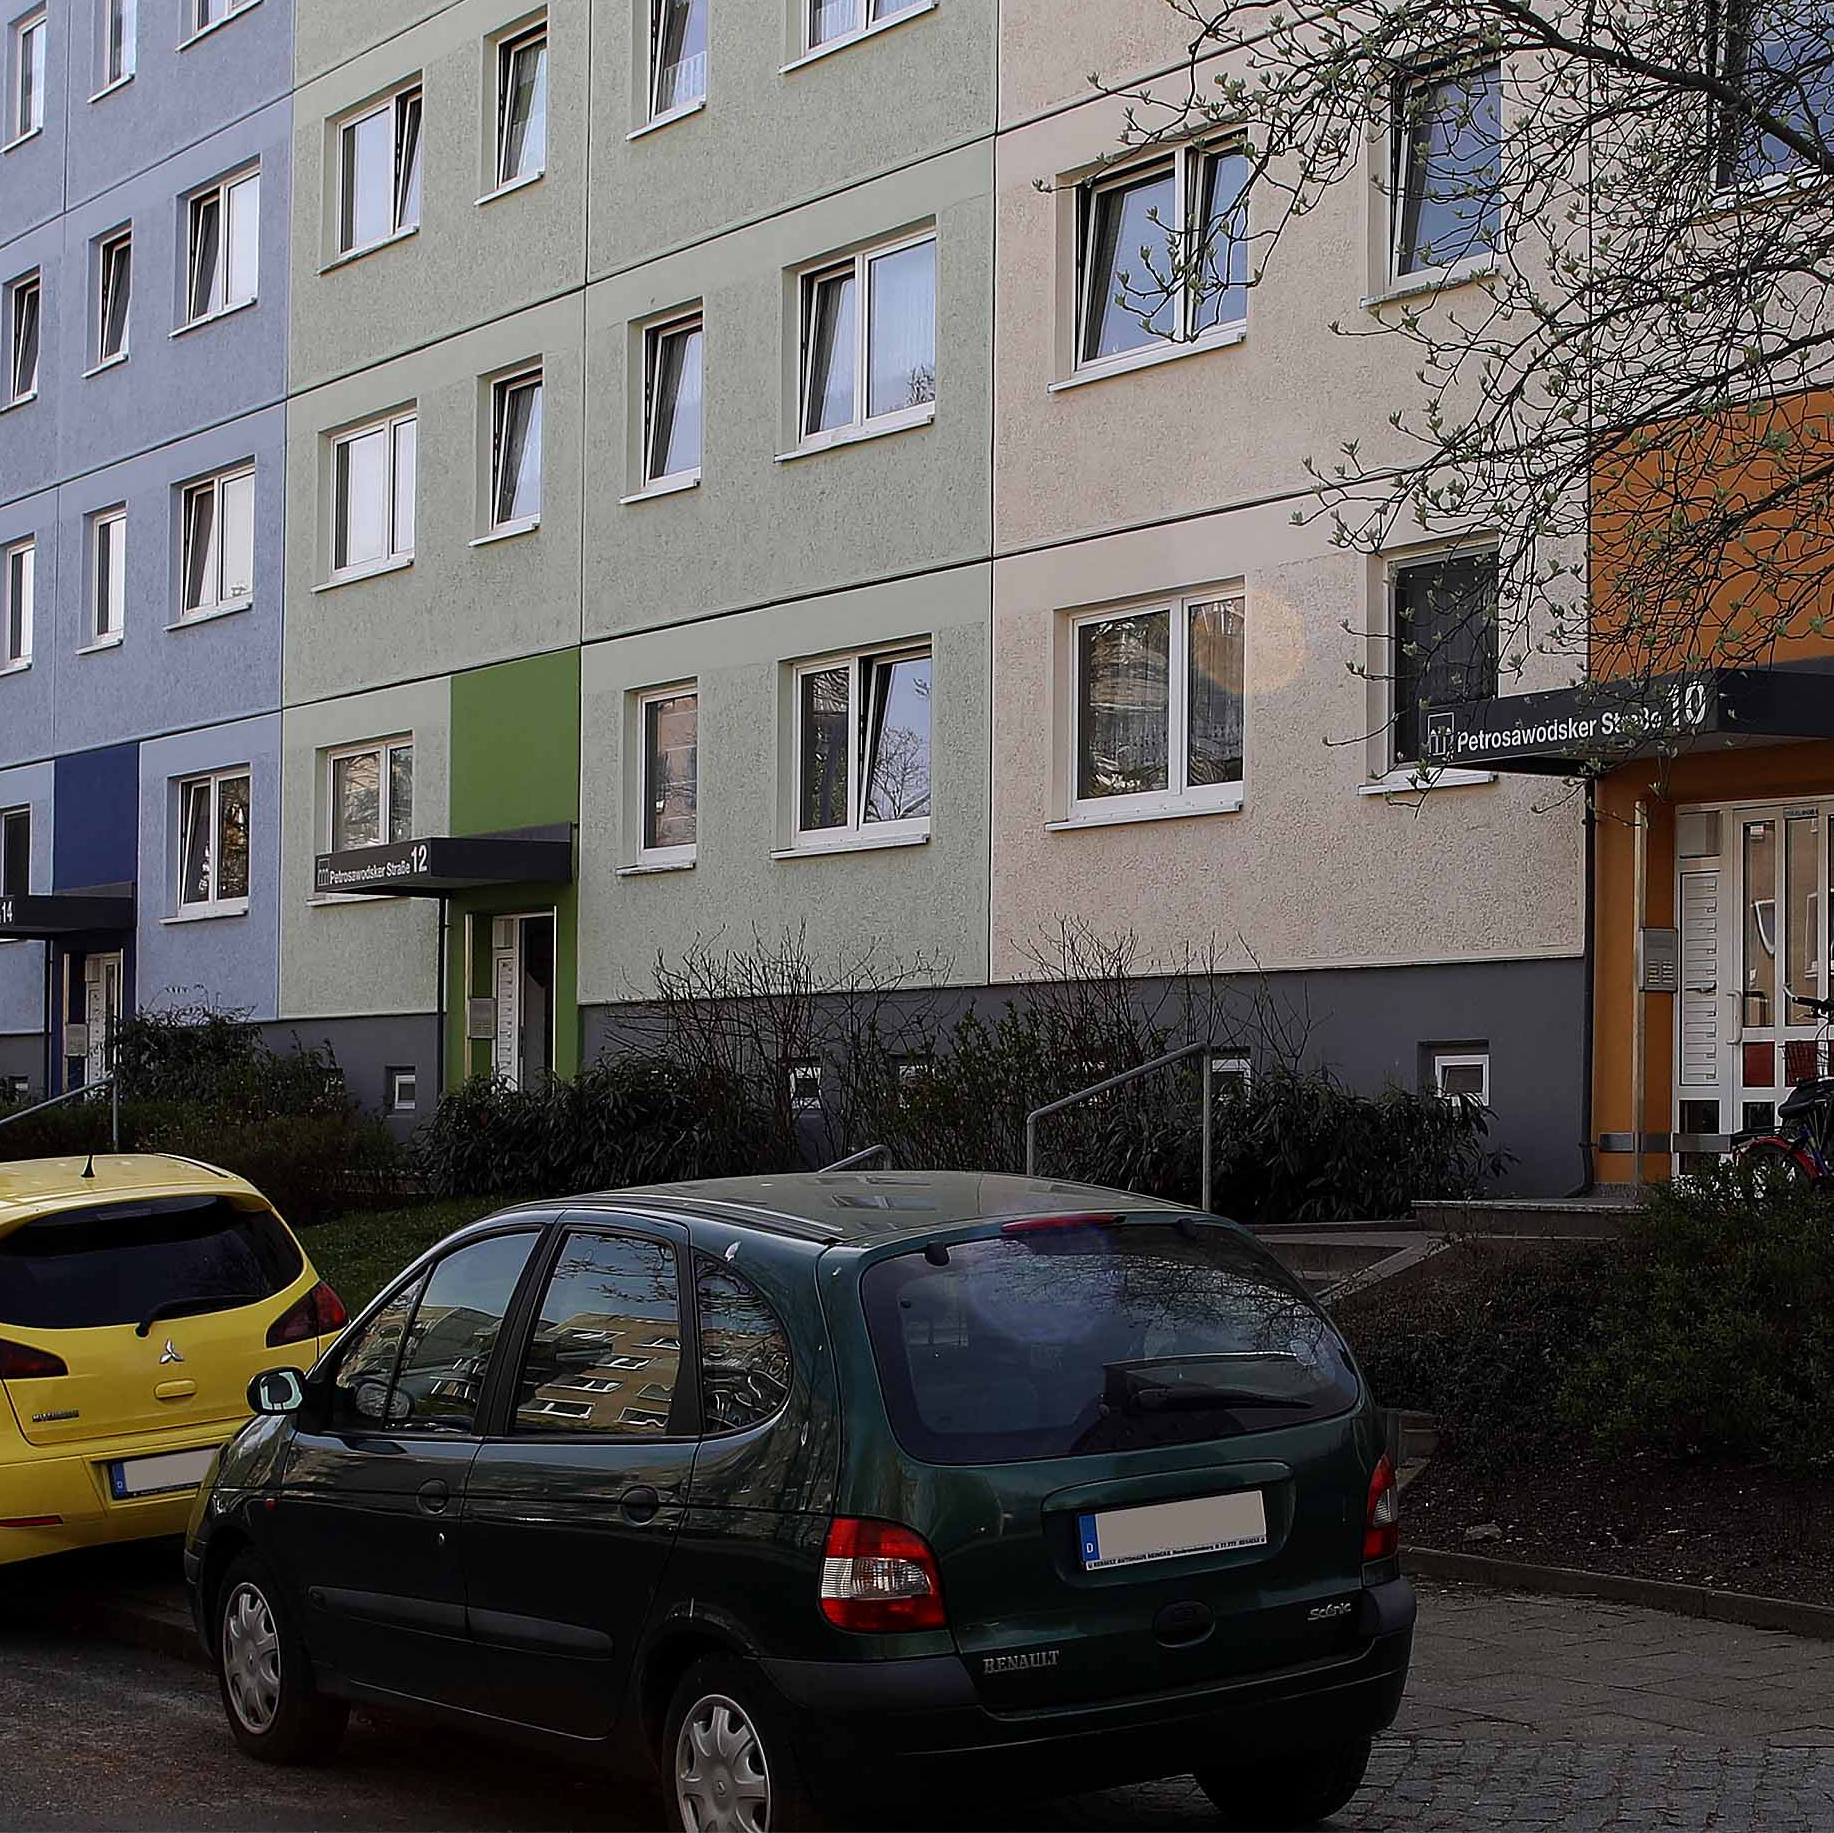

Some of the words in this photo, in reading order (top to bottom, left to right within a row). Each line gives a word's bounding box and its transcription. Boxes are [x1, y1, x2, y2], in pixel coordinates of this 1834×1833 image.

[1457, 718, 1598, 753] Petrosawodsker
[1665, 680, 1707, 726] 10
[386, 860, 411, 877] Straße
[411, 844, 428, 873] 12
[1, 901, 13, 923] 14
[1086, 1542, 1094, 1554] D
[982, 1649, 1060, 1674] RENAULT
